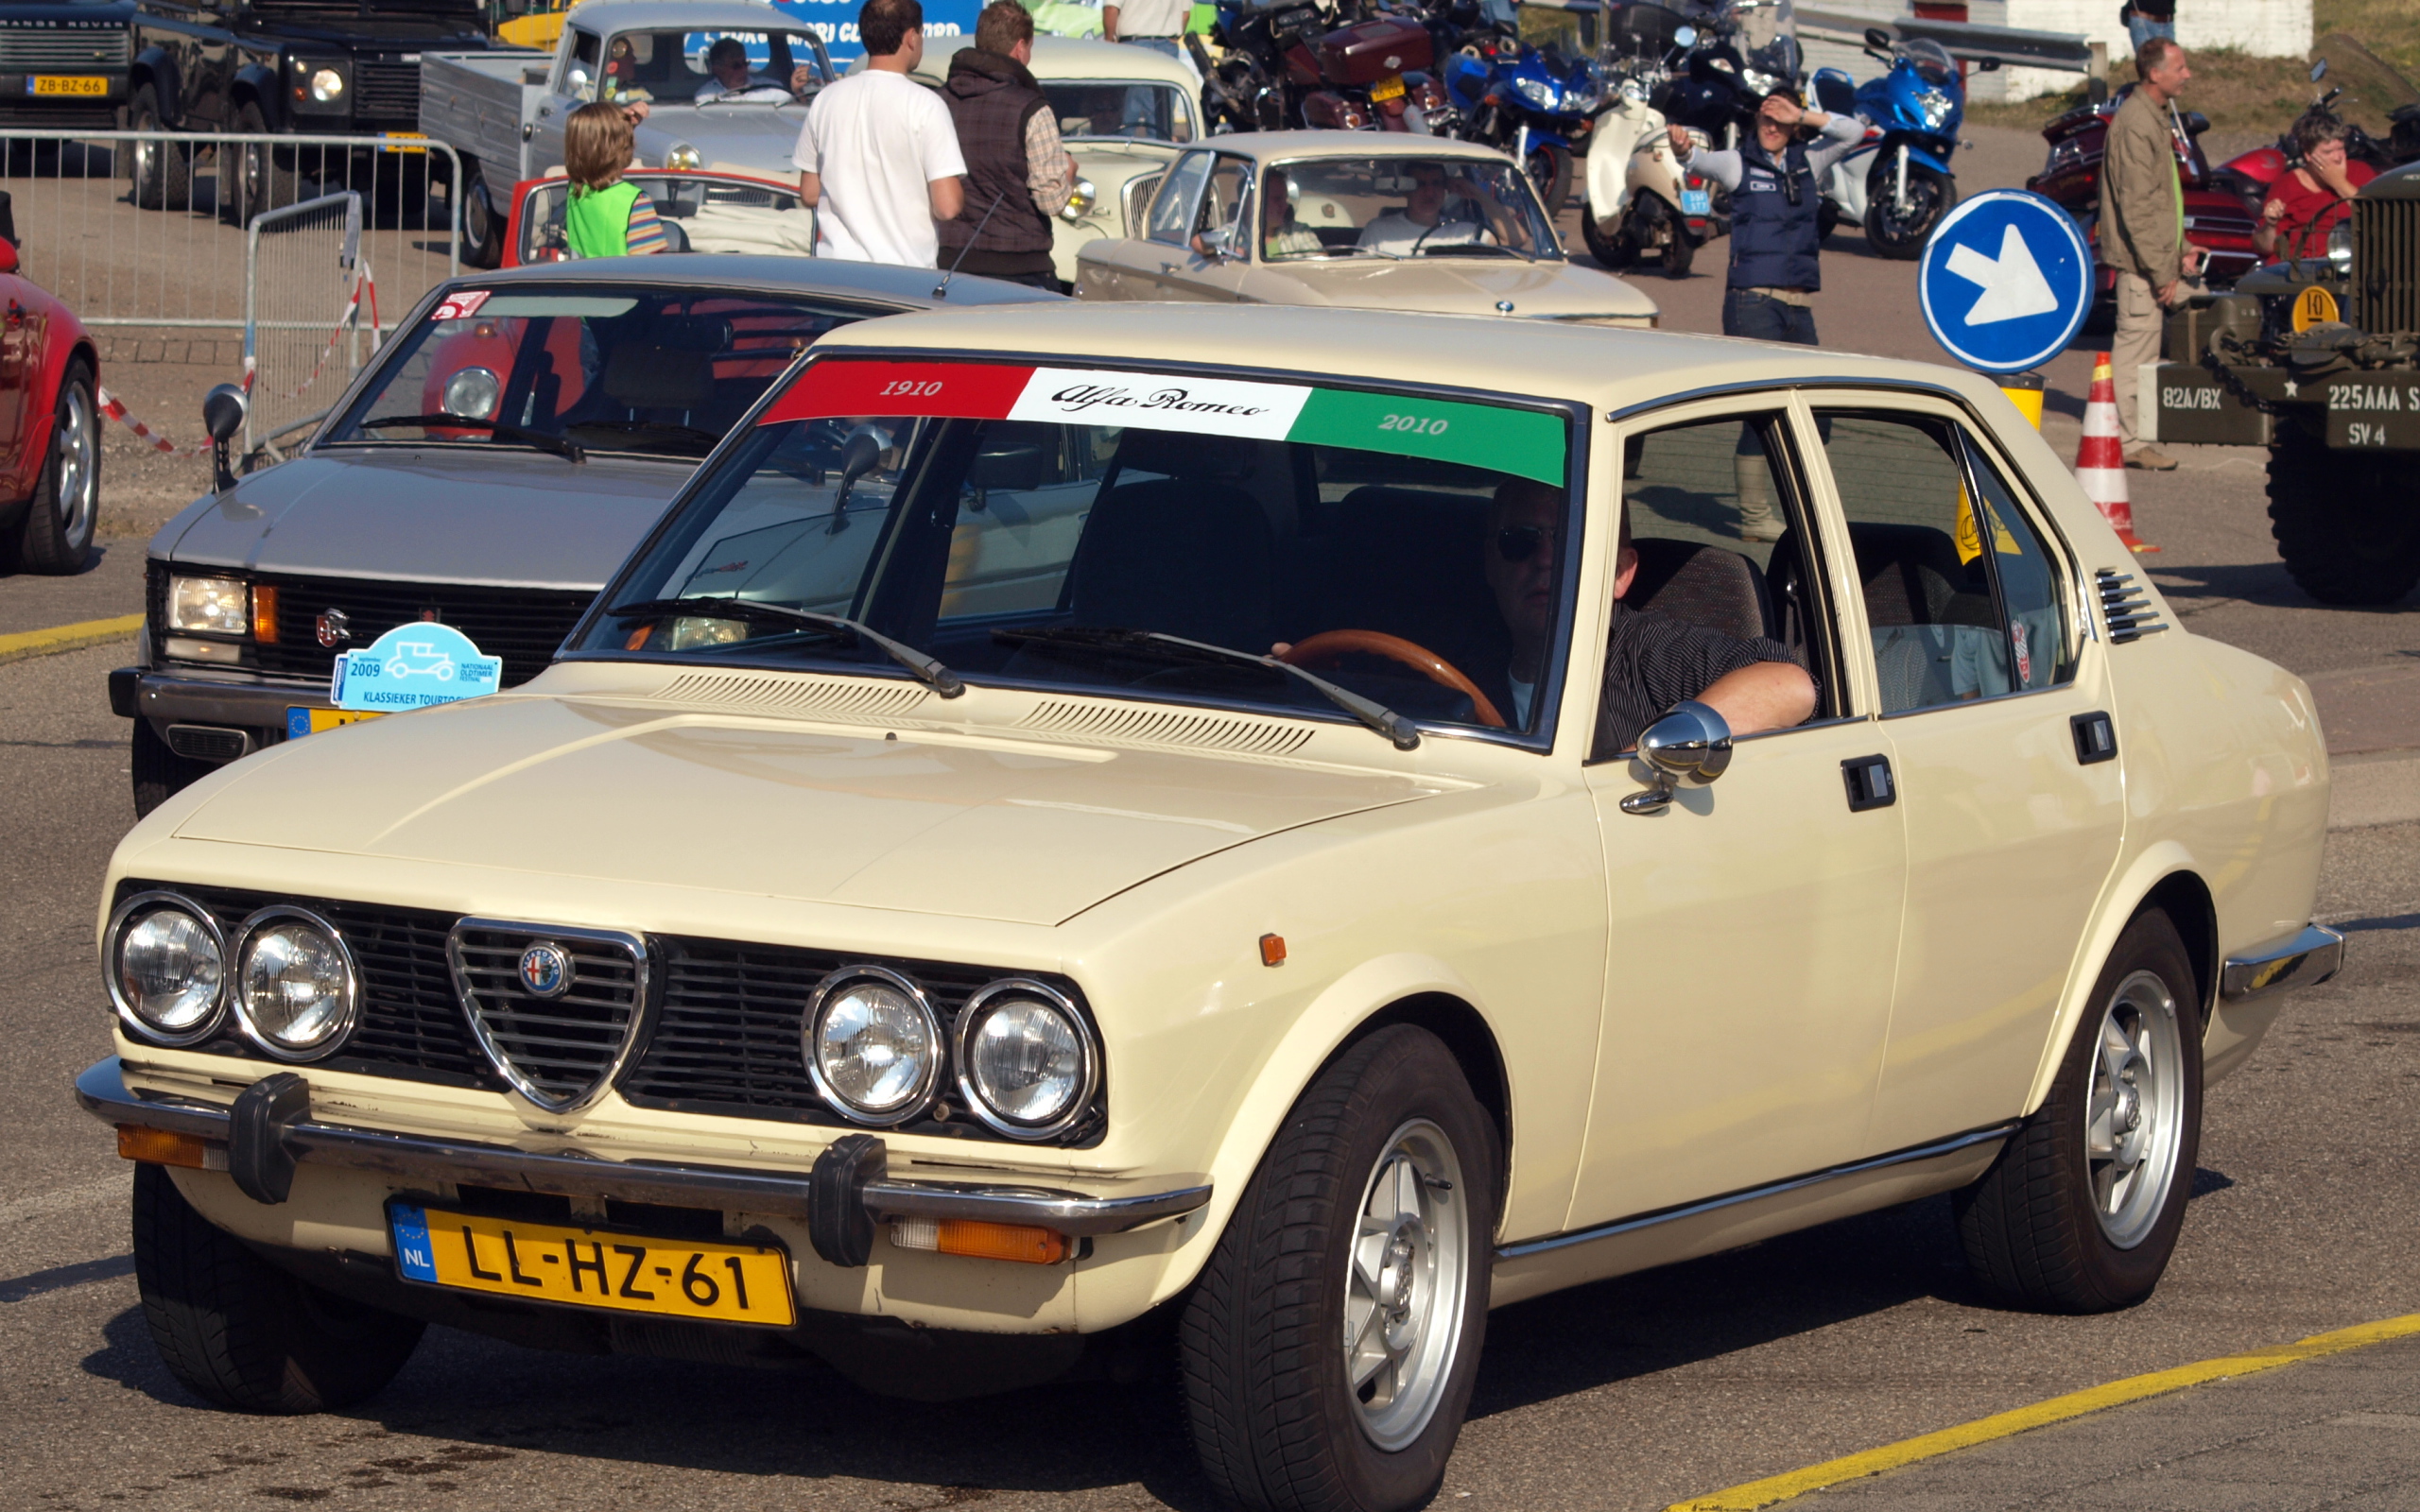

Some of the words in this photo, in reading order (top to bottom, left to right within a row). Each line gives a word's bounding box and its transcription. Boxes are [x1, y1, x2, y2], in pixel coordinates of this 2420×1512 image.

[68, 20, 123, 28] ROVER
[39, 78, 101, 93] ZB-BZ-66
[2162, 387, 2221, 410] 82A/BX
[2328, 384, 2401, 411] 225AAA
[879, 380, 943, 397] 1910
[1050, 383, 1137, 412] Alfa
[1138, 387, 1270, 417] Romeo
[1377, 413, 1449, 436] 2010
[2348, 422, 2371, 446] SV
[2374, 424, 2386, 446] 4
[351, 662, 381, 678] 2009
[459, 669, 493, 678] OLDTIMER
[460, 662, 493, 671] NATIONAAL
[363, 691, 417, 705] KLASSIEKER
[404, 1247, 431, 1268] NL
[460, 1224, 752, 1311] LL-HZ-61
